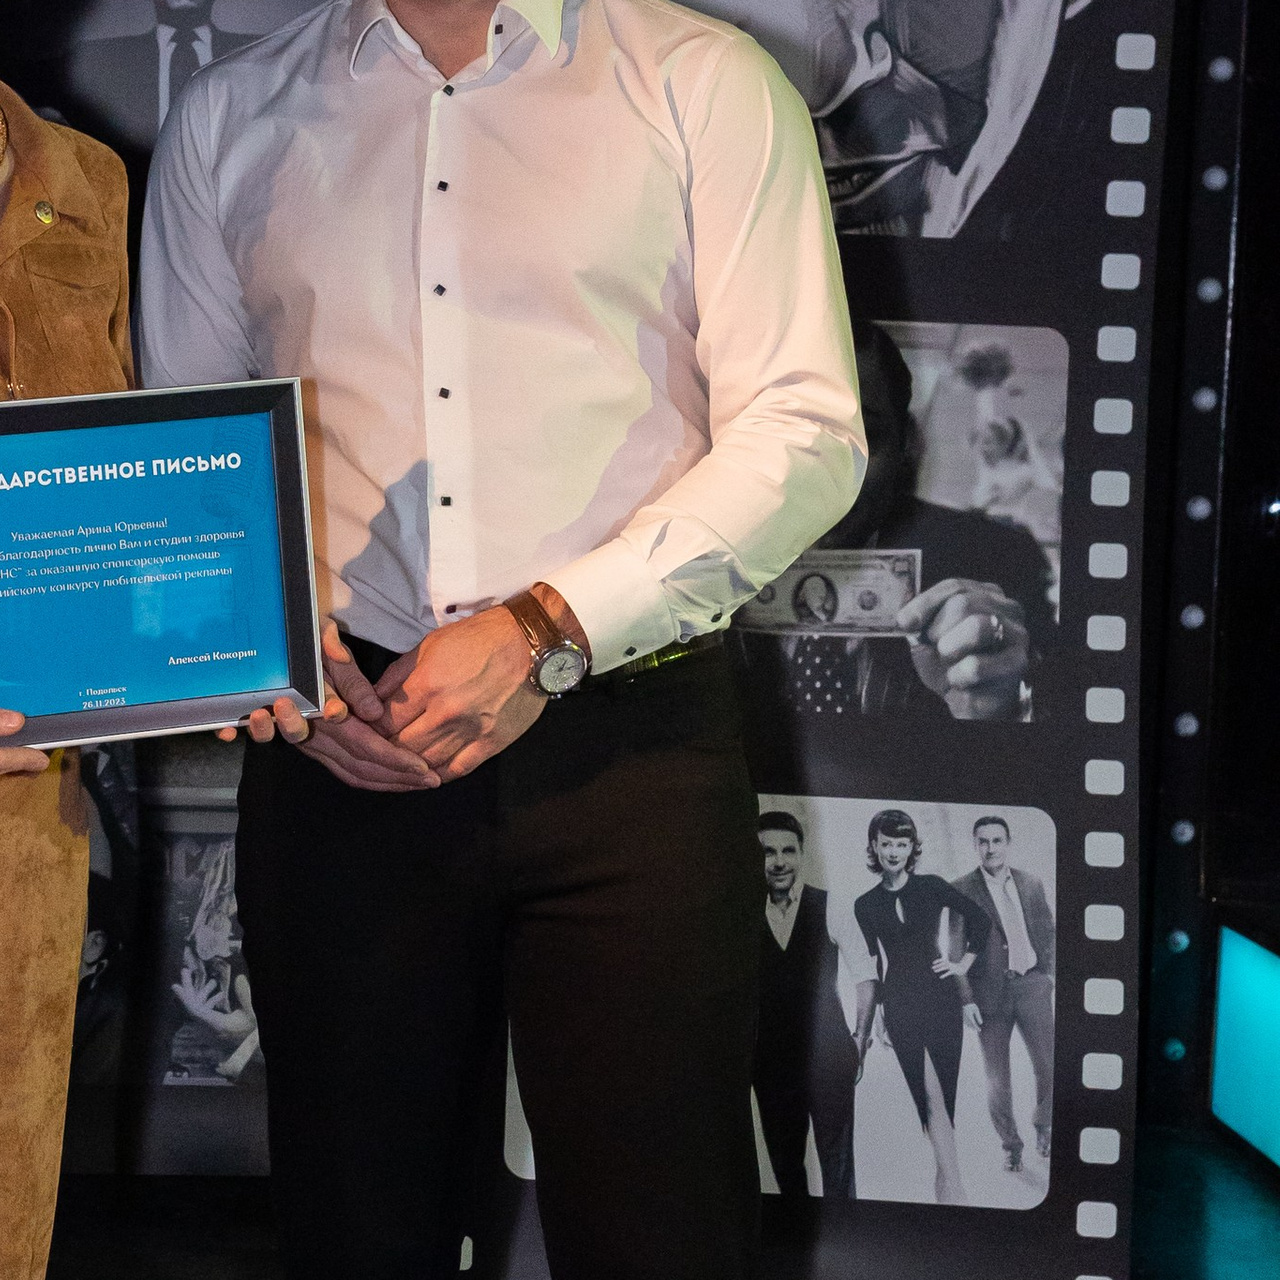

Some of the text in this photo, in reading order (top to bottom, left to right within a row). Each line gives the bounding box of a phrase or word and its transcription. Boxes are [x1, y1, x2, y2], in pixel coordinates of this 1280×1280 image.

[152, 452, 242, 476] ПИСЬМО
[11, 518, 168, 542] Уважаемая Арина Юрьевна!
[84, 542, 117, 553] лично
[119, 539, 142, 550] Вам
[144, 539, 152, 547] и
[154, 535, 192, 548] студии
[195, 530, 245, 543] здоровья
[25, 568, 38, 577] за
[40, 562, 100, 576] оказанную
[102, 555, 175, 569] спонсорскую
[177, 550, 220, 563] помощь
[50, 580, 100, 593] конкурсу
[103, 570, 182, 587] любительской
[184, 567, 233, 581] рекламы
[168, 648, 257, 666] Алексей Кокорин
[86, 685, 127, 697] Подольск
[82, 697, 126, 709] 26.11.2023
